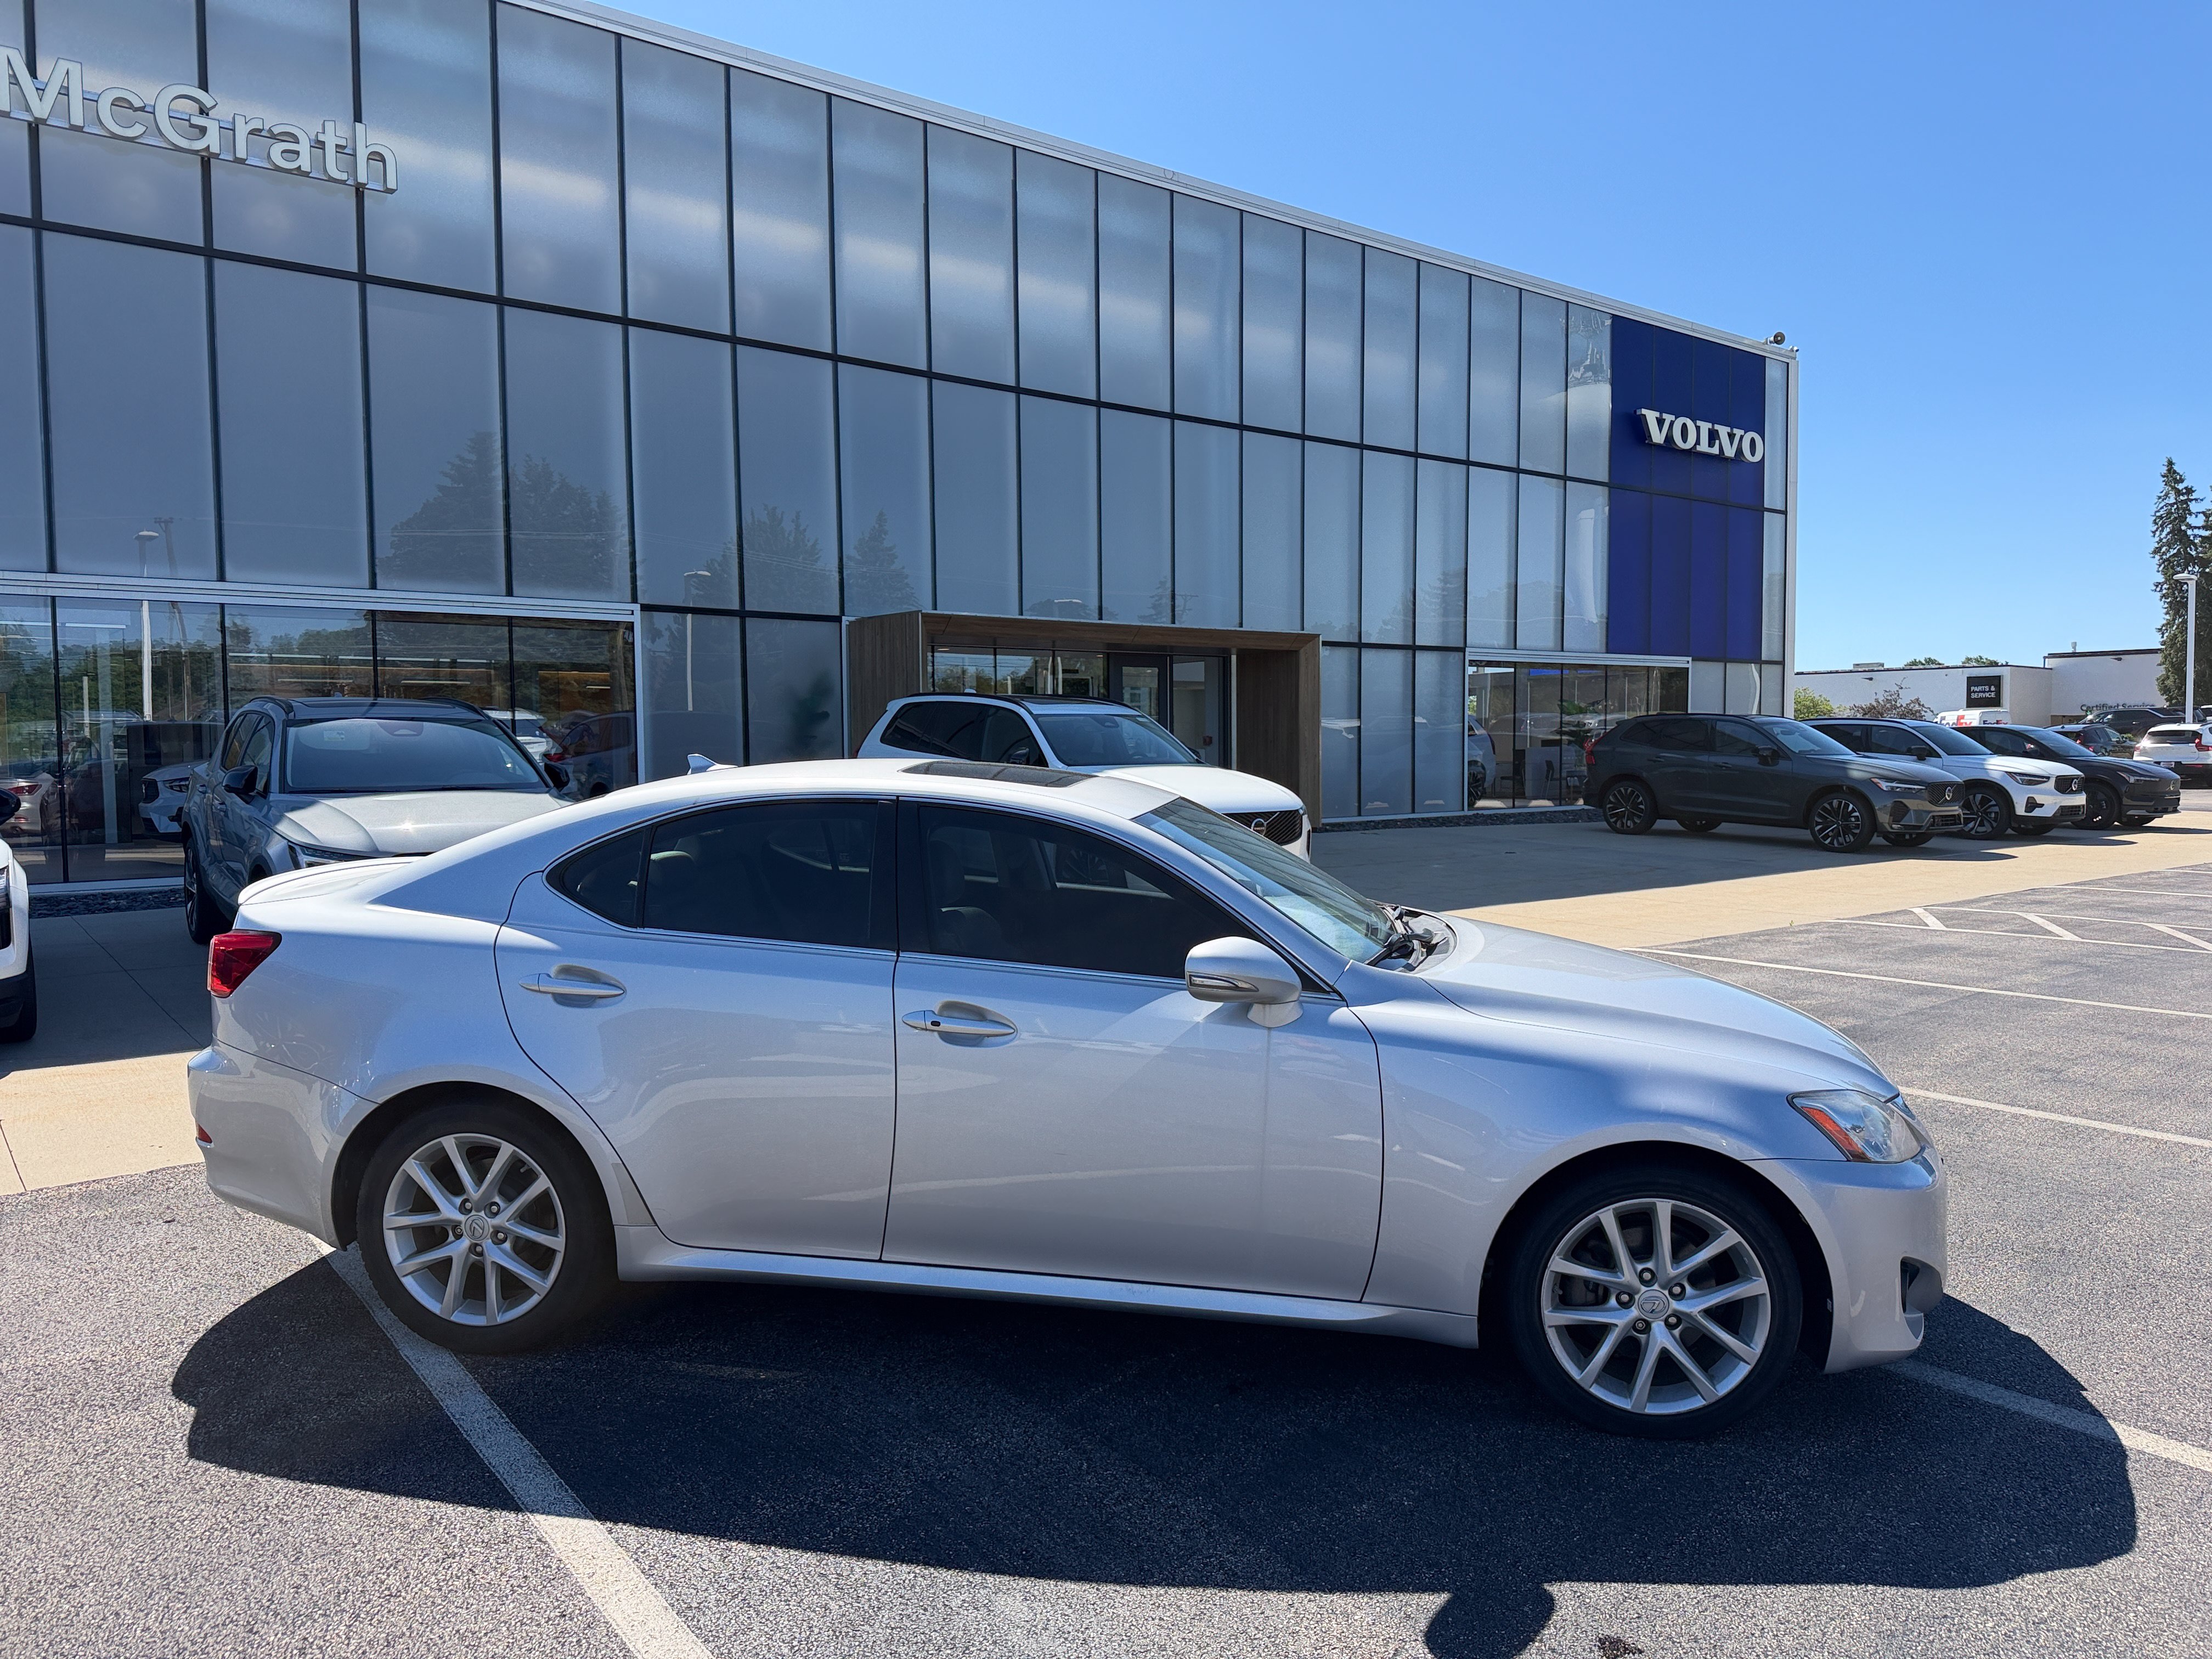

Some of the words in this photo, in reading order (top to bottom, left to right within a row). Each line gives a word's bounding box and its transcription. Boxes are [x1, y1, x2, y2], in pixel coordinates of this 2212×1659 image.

[0, 44, 398, 194] McGrath
[1635, 408, 1764, 463] VOLVO
[2080, 703, 2119, 712] Certified
